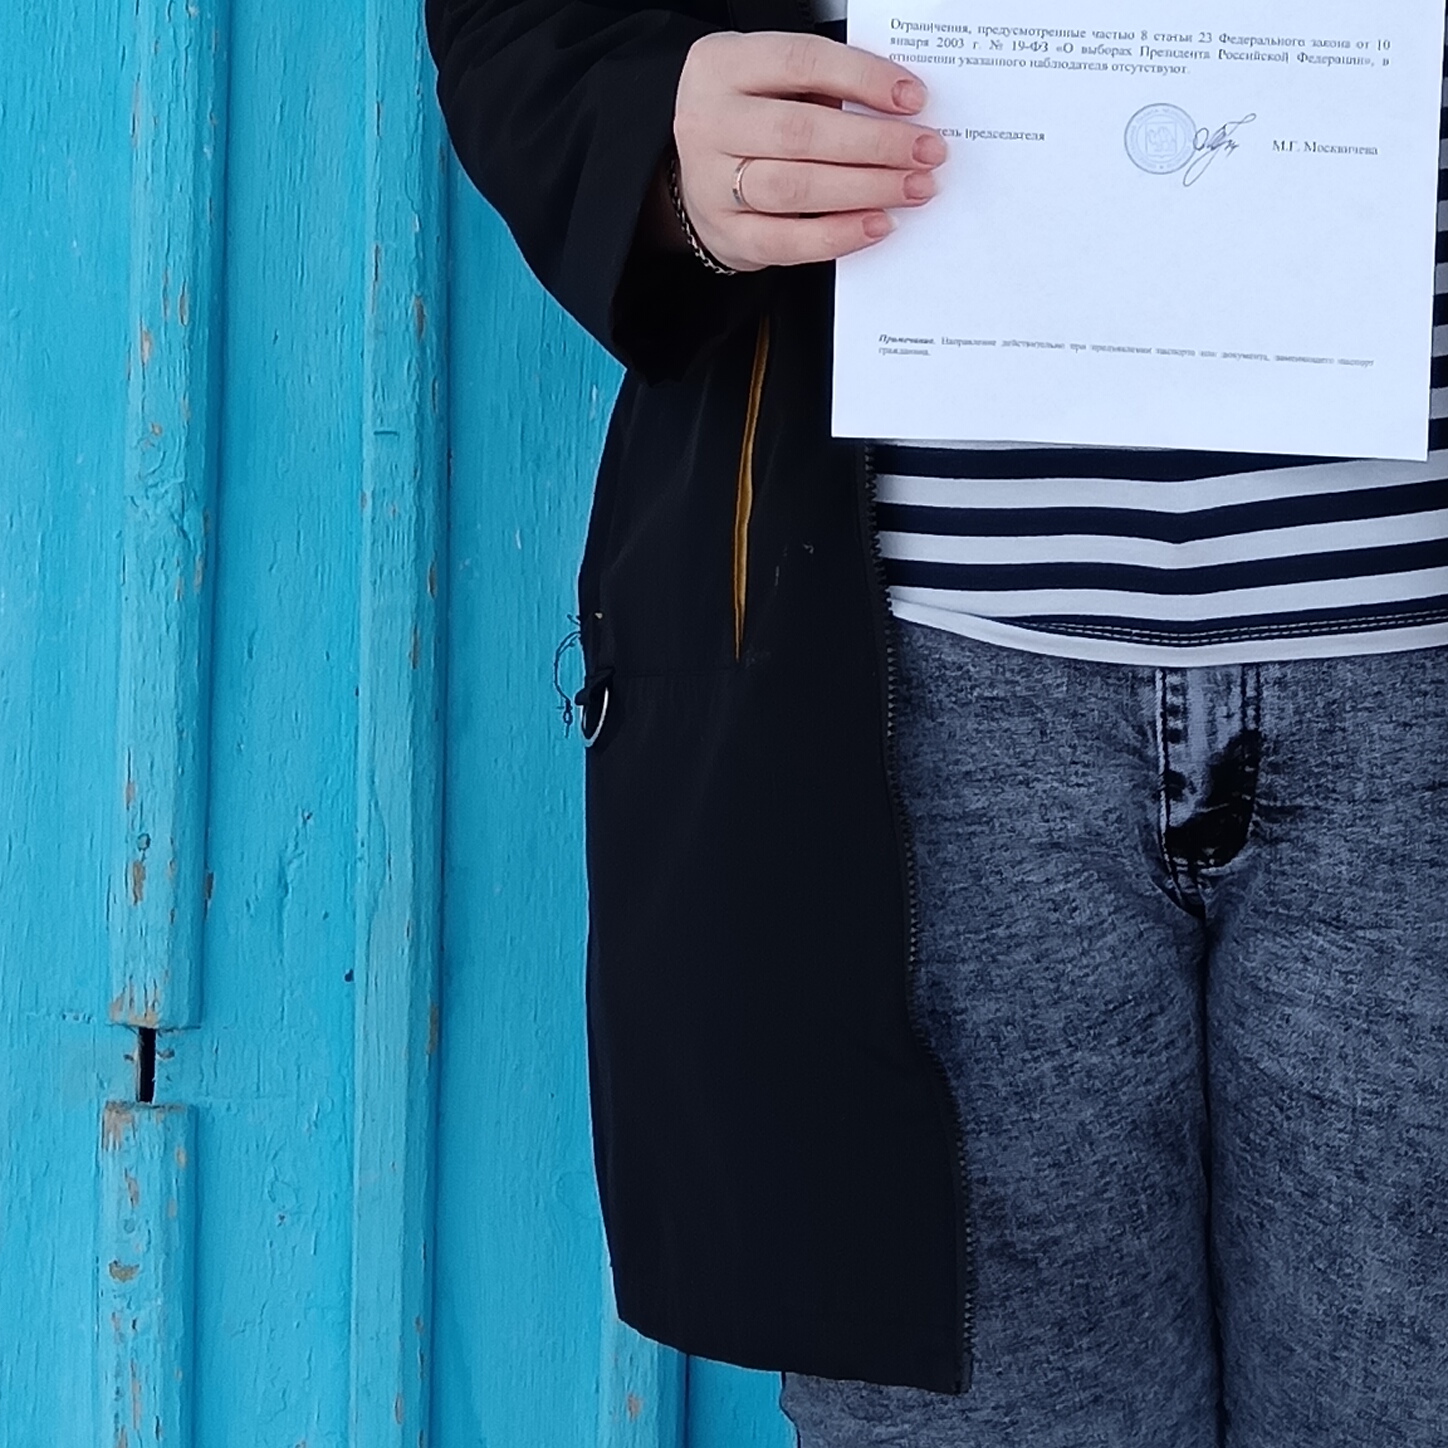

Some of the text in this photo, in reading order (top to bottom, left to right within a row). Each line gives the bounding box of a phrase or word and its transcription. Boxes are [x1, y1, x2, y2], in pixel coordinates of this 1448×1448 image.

[936, 37, 964, 49] 2003
[1198, 31, 1212, 43] 23
[1377, 39, 1390, 51] 10
